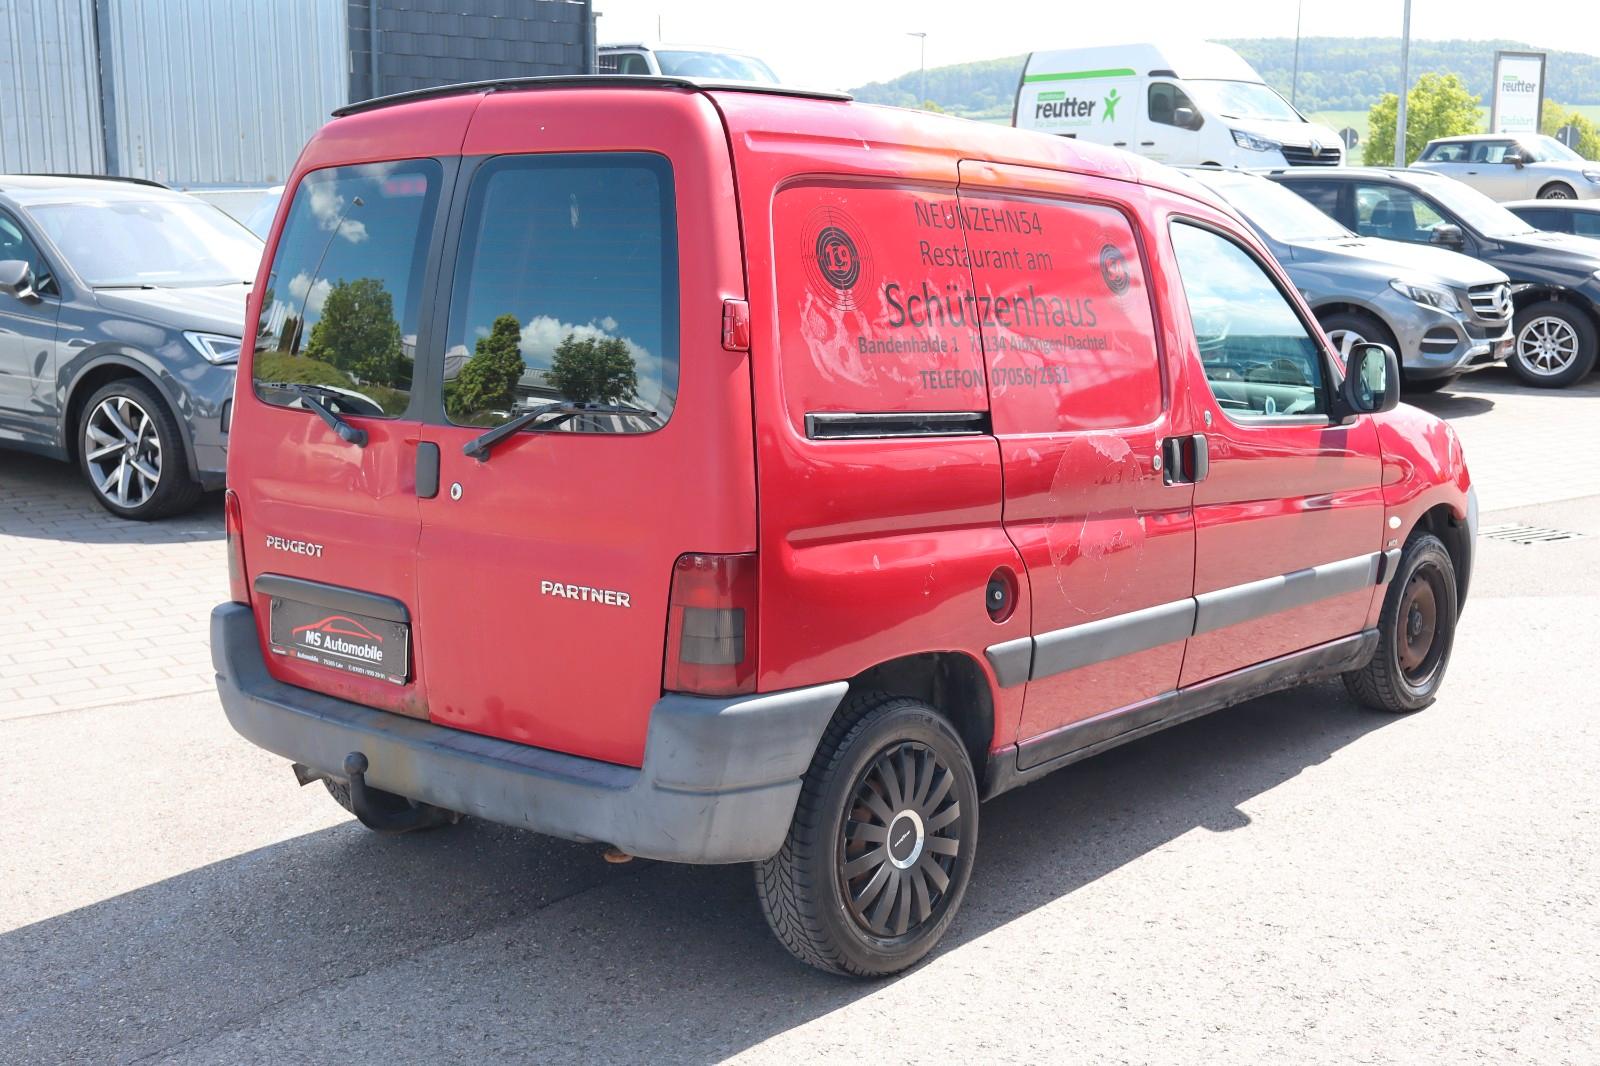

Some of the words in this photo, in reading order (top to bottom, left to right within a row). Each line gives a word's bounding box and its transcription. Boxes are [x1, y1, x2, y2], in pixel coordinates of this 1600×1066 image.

[1502, 80, 1537, 93] reutter
[1035, 96, 1096, 119] reutter
[914, 202, 1043, 235] NEUNZEHN54
[920, 240, 1023, 271] Restaurant
[1026, 252, 1053, 271] am
[885, 282, 1097, 328] Schützenhaus
[858, 335, 948, 354] Bandenhalde
[952, 336, 961, 353] 1
[920, 369, 984, 389] TELEFON
[266, 535, 323, 557] PEUGEOT
[541, 580, 631, 608] PARTNER
[305, 630, 321, 646] MS
[324, 636, 383, 661] Automobile
